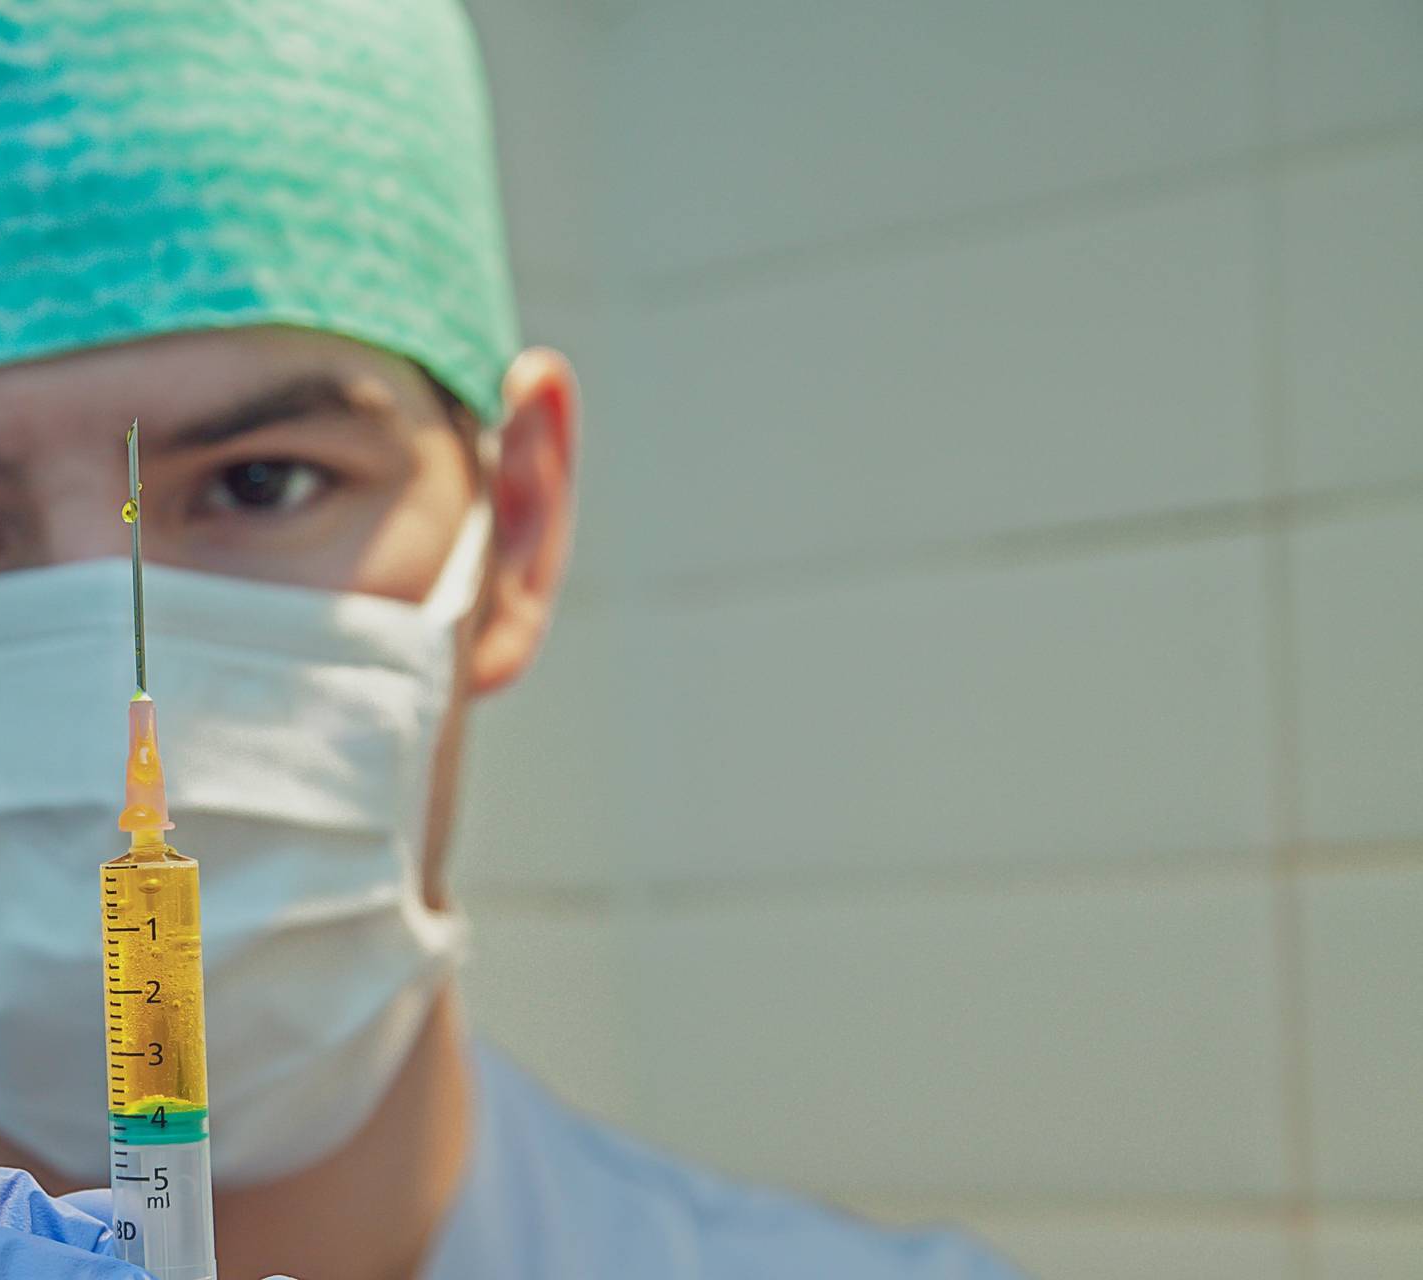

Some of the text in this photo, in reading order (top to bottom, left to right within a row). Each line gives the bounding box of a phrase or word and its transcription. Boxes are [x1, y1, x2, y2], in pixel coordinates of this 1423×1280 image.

[146, 917, 157, 940] 1
[145, 980, 162, 1004] 2
[148, 1042, 164, 1066] 3
[150, 1105, 167, 1129] 4
[154, 1167, 169, 1191] 5
[146, 1192, 170, 1209] ml
